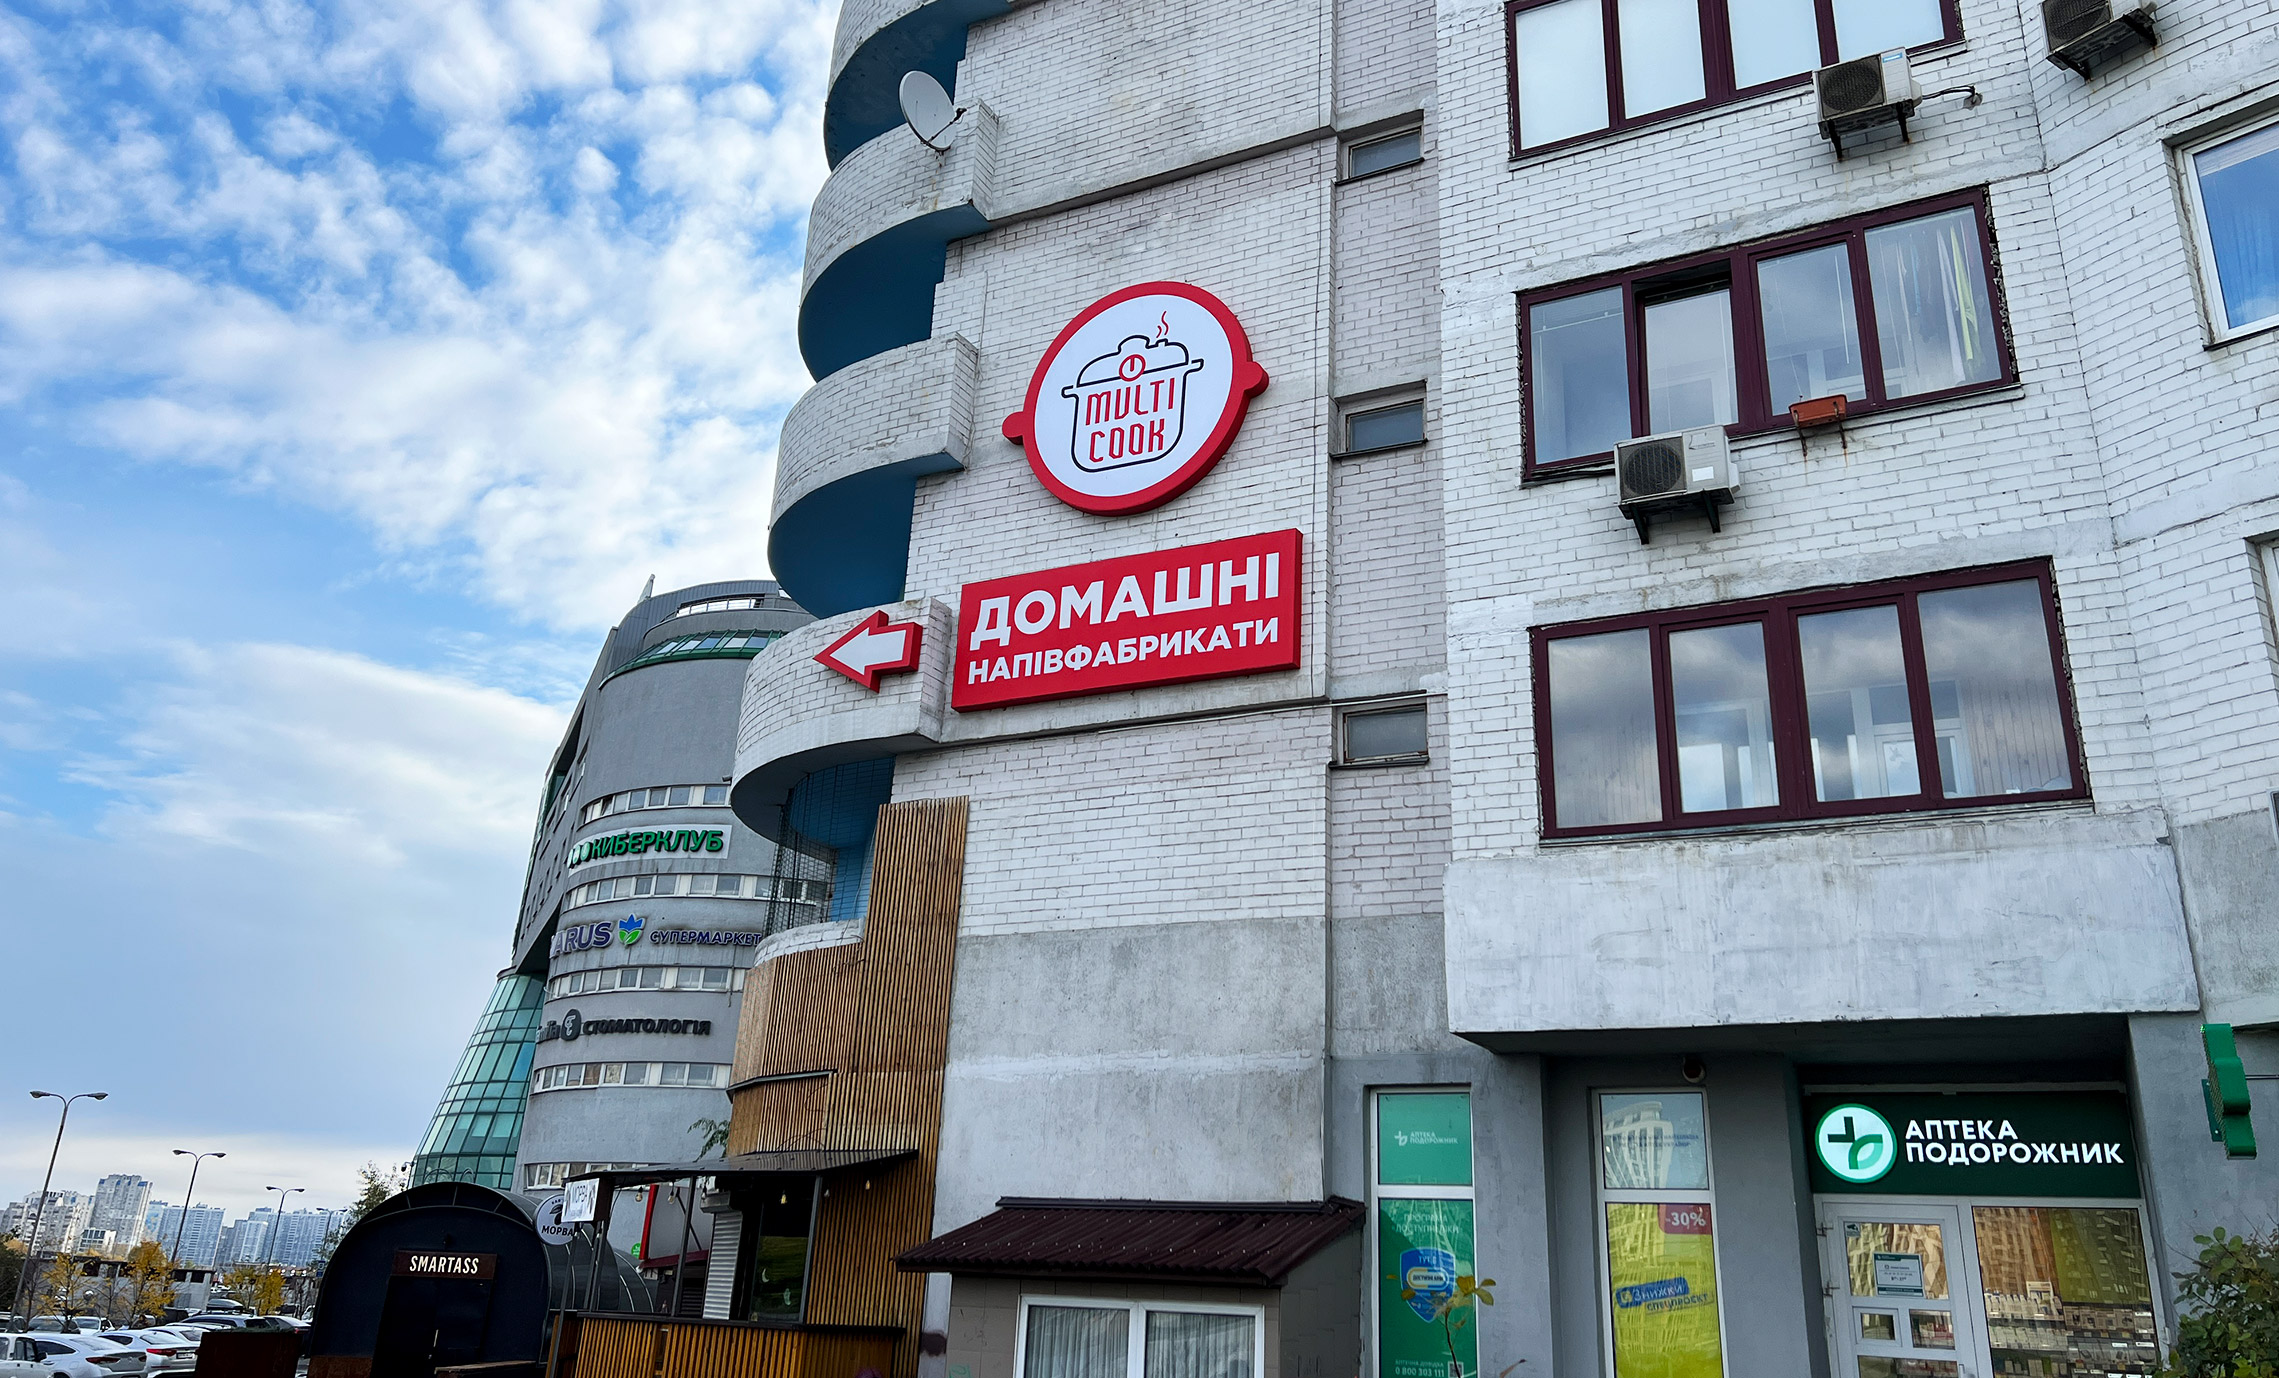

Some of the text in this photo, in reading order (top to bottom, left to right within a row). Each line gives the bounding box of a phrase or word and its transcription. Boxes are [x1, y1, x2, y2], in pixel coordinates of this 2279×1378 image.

[1085, 377, 1175, 426] MULTI
[1089, 418, 1165, 463] COOK
[969, 552, 1280, 651] ДОМАШНІ
[968, 617, 1279, 685] НАПІВФАБРИКАТИ
[649, 929, 762, 946] СУПЕРМАРКЕТ
[582, 1018, 712, 1036] СТОМАТОЛОГІЯ
[1904, 1119, 2018, 1140] АПТЕКА
[1905, 1142, 2125, 1166] ПОДОРОЖНИК
[409, 1255, 479, 1275] SMARTASS
